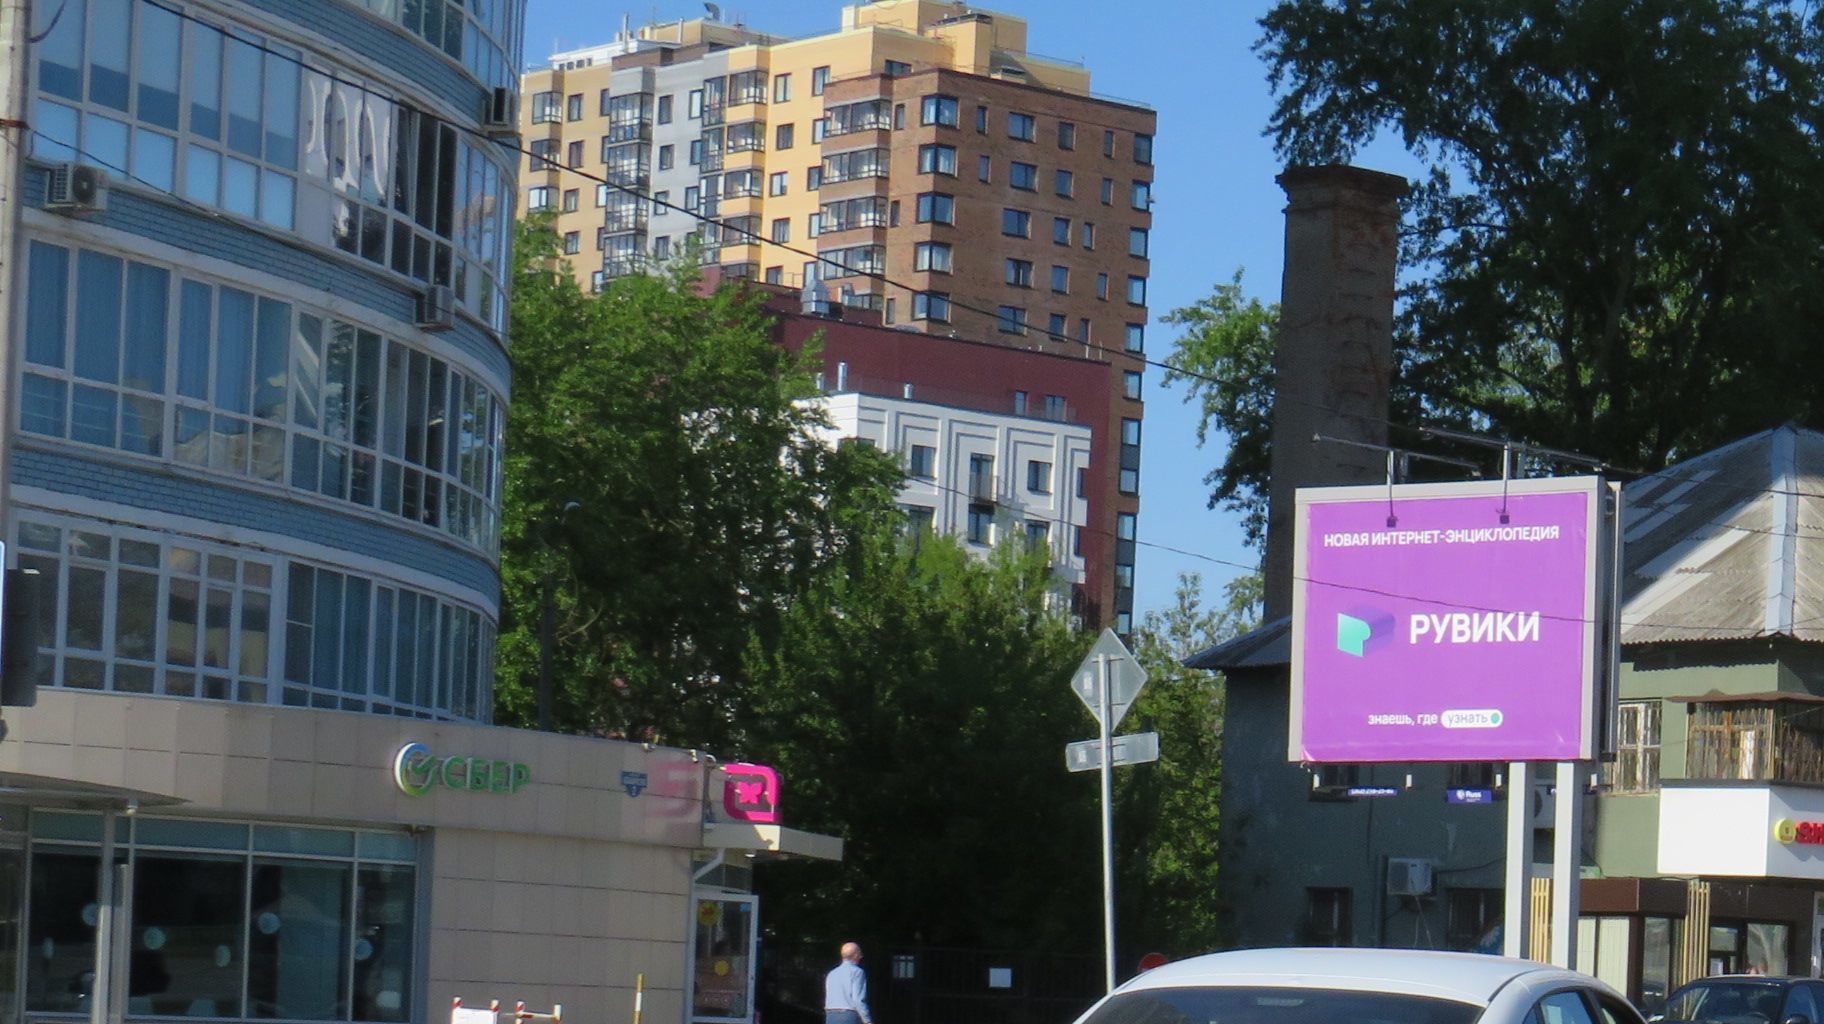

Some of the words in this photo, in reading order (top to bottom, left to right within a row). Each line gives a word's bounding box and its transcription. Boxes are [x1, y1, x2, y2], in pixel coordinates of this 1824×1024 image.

[1324, 532, 1369, 547] НОВАЯ
[1371, 525, 1559, 546] ИНТЕРНЕТ-ЭНЦИКЛОПЕДИЯ
[1409, 611, 1540, 644] РУВИКИ
[1367, 712, 1415, 727] знаешь,
[1417, 713, 1438, 727] где
[1447, 711, 1488, 728] узнать
[442, 756, 531, 795] СБЕР
